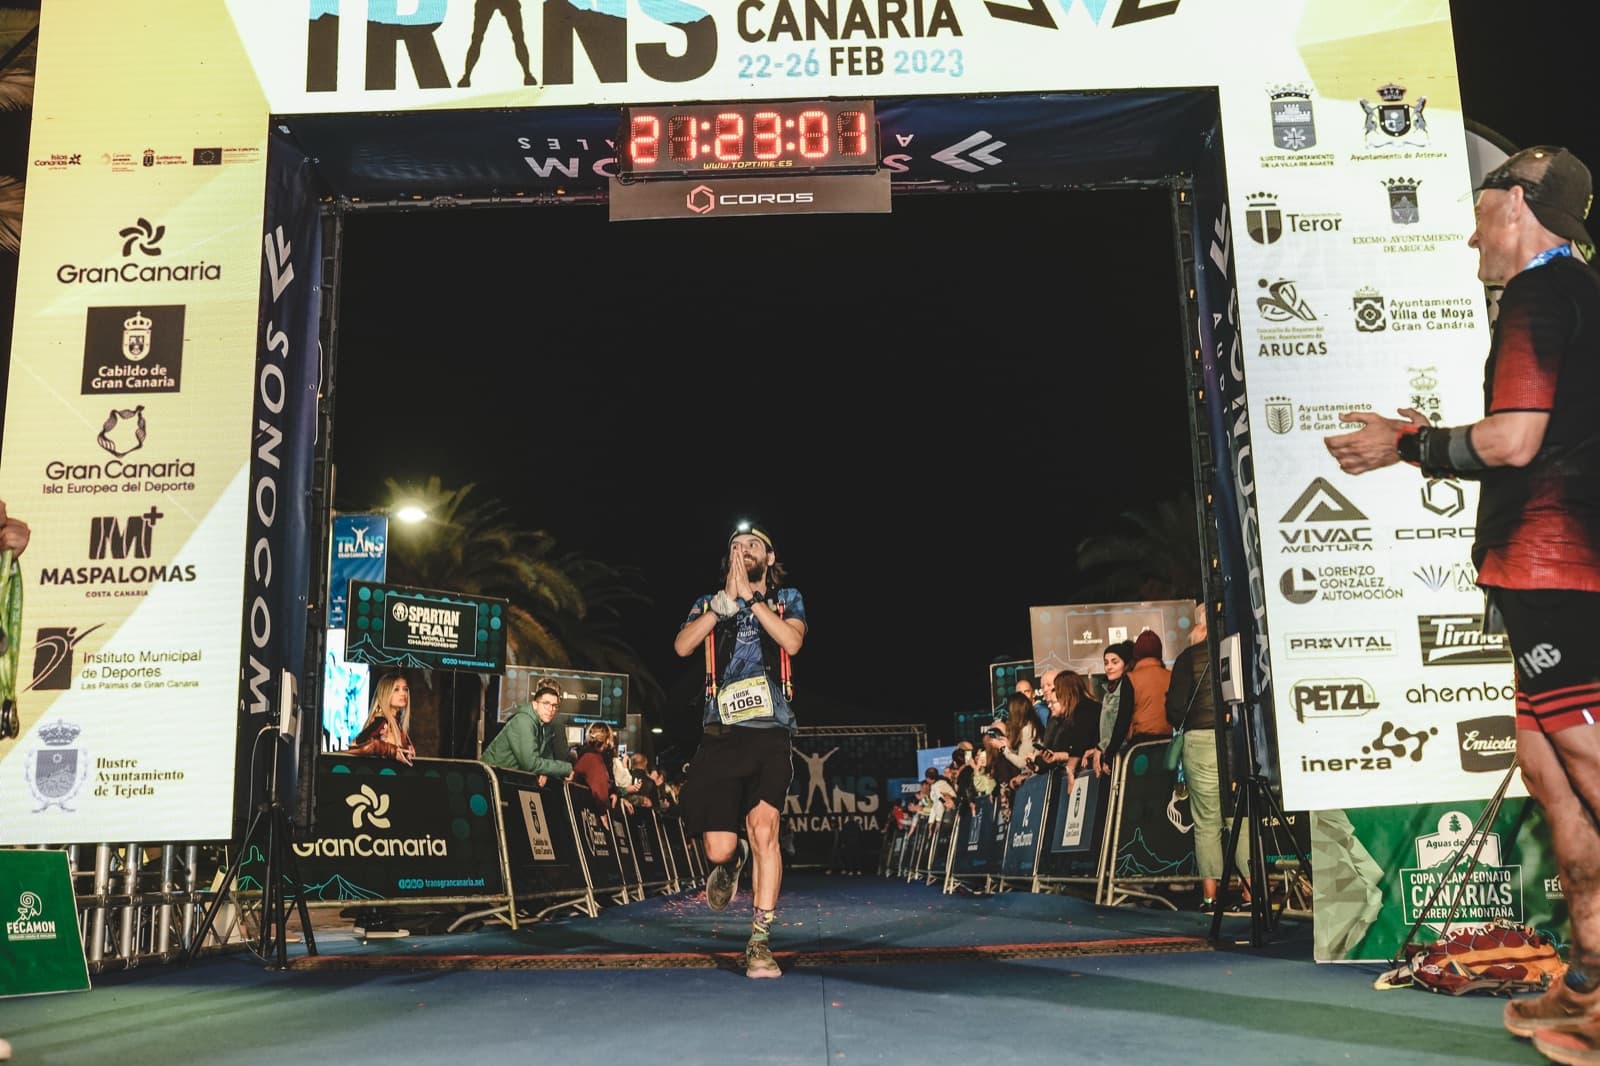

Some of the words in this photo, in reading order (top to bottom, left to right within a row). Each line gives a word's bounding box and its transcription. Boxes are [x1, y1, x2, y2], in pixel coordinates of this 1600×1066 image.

[737, 0, 963, 42] CANARIA
[738, 48, 820, 78] 22-26
[829, 46, 884, 76] FEB
[894, 48, 964, 77] 2023
[630, 110, 867, 163] 21:23:01
[703, 160, 793, 170] WWW.TOPTIME.ES
[719, 192, 814, 206] COROS
[1286, 213, 1342, 232] Teror
[57, 261, 221, 284] GranCanaria
[1390, 296, 1472, 308] Ayuntamiento
[1390, 309, 1417, 320] Villa
[1422, 309, 1437, 319] de
[1441, 308, 1474, 321] Moya
[1392, 322, 1422, 331] Gran
[1426, 320, 1475, 330] Canaria
[1258, 341, 1328, 357] ARUCAS
[98, 365, 148, 378] Cabildo
[150, 365, 167, 376] de
[92, 377, 123, 389] Gran
[125, 376, 175, 388] Canaria
[1298, 403, 1372, 412] Ayuntamiento
[1317, 413, 1332, 421] Las
[1314, 422, 1336, 430] Gran
[46, 461, 101, 480] Gran
[104, 459, 195, 479] Canaria
[43, 483, 63, 494] Isla
[67, 483, 118, 495] Europea
[122, 482, 141, 492] del
[144, 481, 195, 493] Deporte
[1279, 528, 1373, 544] VIVAC
[1281, 544, 1373, 553] AVENTURA
[40, 565, 196, 585] MASPALOMAS
[1318, 565, 1376, 577] LORENZO
[114, 590, 149, 598] CANARIA
[409, 606, 460, 627] SPARTAN
[408, 621, 459, 639] TRAIL
[421, 635, 445, 643] WORLD
[83, 651, 135, 664] Instituto
[139, 649, 202, 664] Municipal
[82, 668, 97, 679] de
[102, 666, 162, 680] Deportes
[729, 695, 763, 711] 1069
[1294, 683, 1380, 723] PETZL
[97, 757, 138, 769] Ilustre
[1301, 755, 1392, 773] inerza
[96, 771, 185, 785] Ayuntamiento
[94, 785, 109, 796] de
[112, 784, 155, 799] Tejeda
[1426, 839, 1451, 848] Aguas
[1453, 838, 1465, 847] de
[1410, 872, 1436, 885] COPA
[1411, 884, 1513, 907] CANARIAS
[1461, 908, 1467, 918] X
[1469, 905, 1514, 918] MONTAÑA
[6, 921, 56, 934] FECAMON
